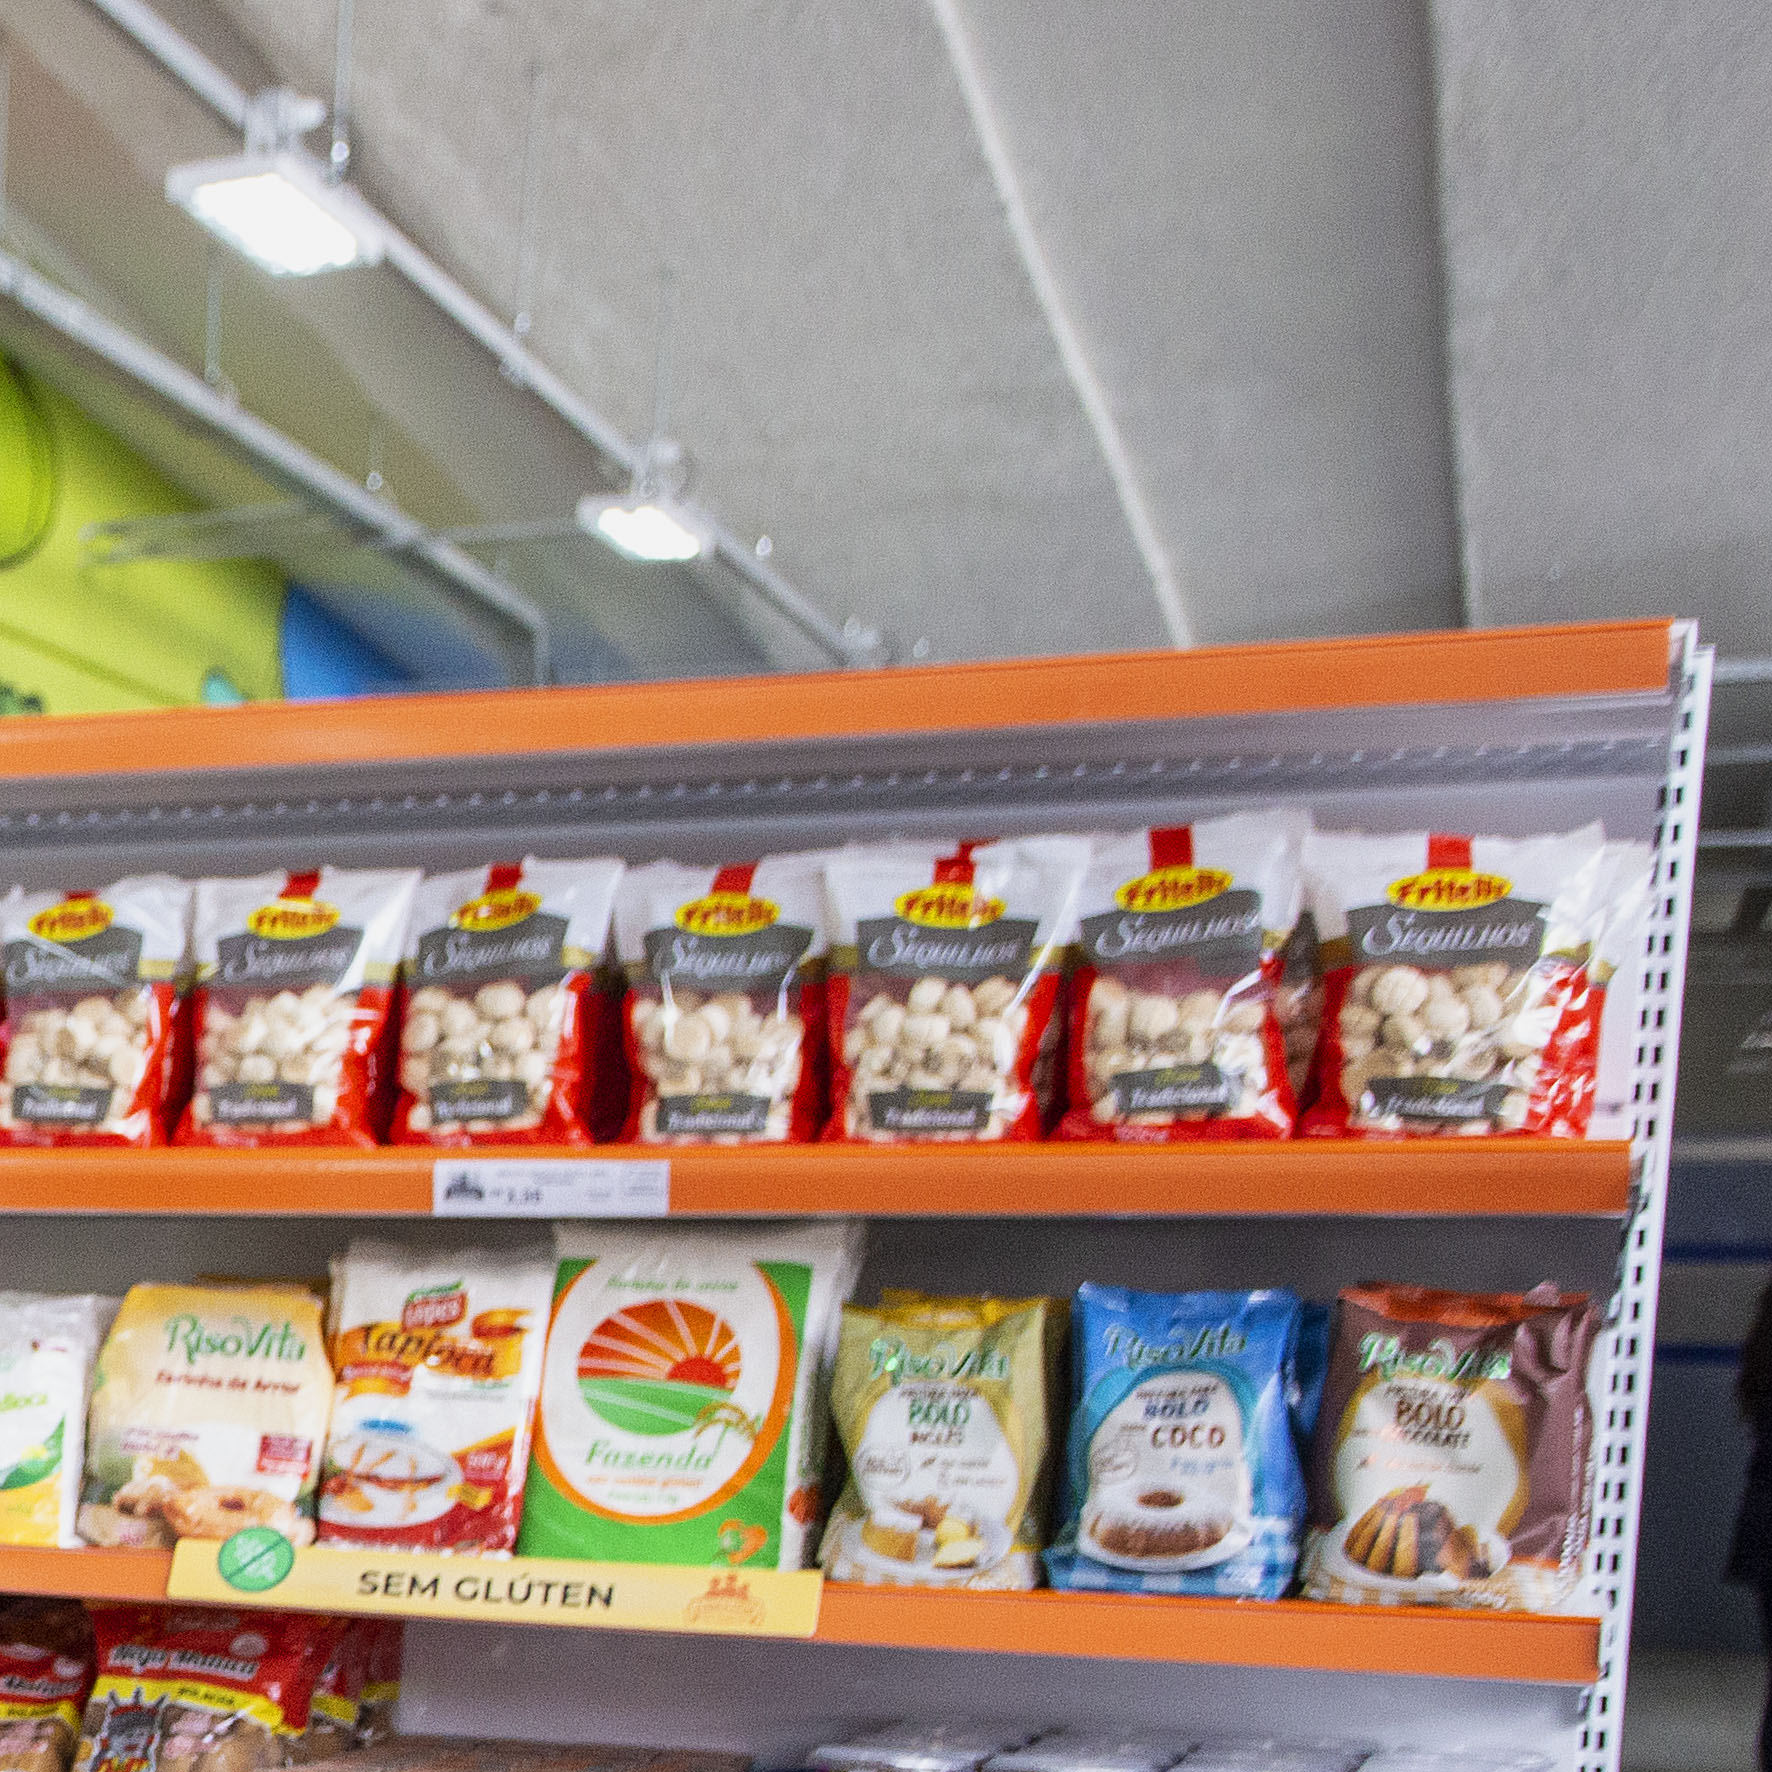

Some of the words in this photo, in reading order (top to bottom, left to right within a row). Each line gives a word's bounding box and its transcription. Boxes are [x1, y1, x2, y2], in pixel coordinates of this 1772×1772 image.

[164, 1313, 307, 1366] RisoVita
[907, 1400, 971, 1428] BOLO
[1143, 1400, 1210, 1420] BOLO
[1395, 1401, 1467, 1431] BOLO
[1150, 1425, 1227, 1451] COCO
[583, 1437, 717, 1472] Fazenda
[358, 1568, 440, 1601] SEM
[455, 1569, 615, 1610] GLÚTEN
